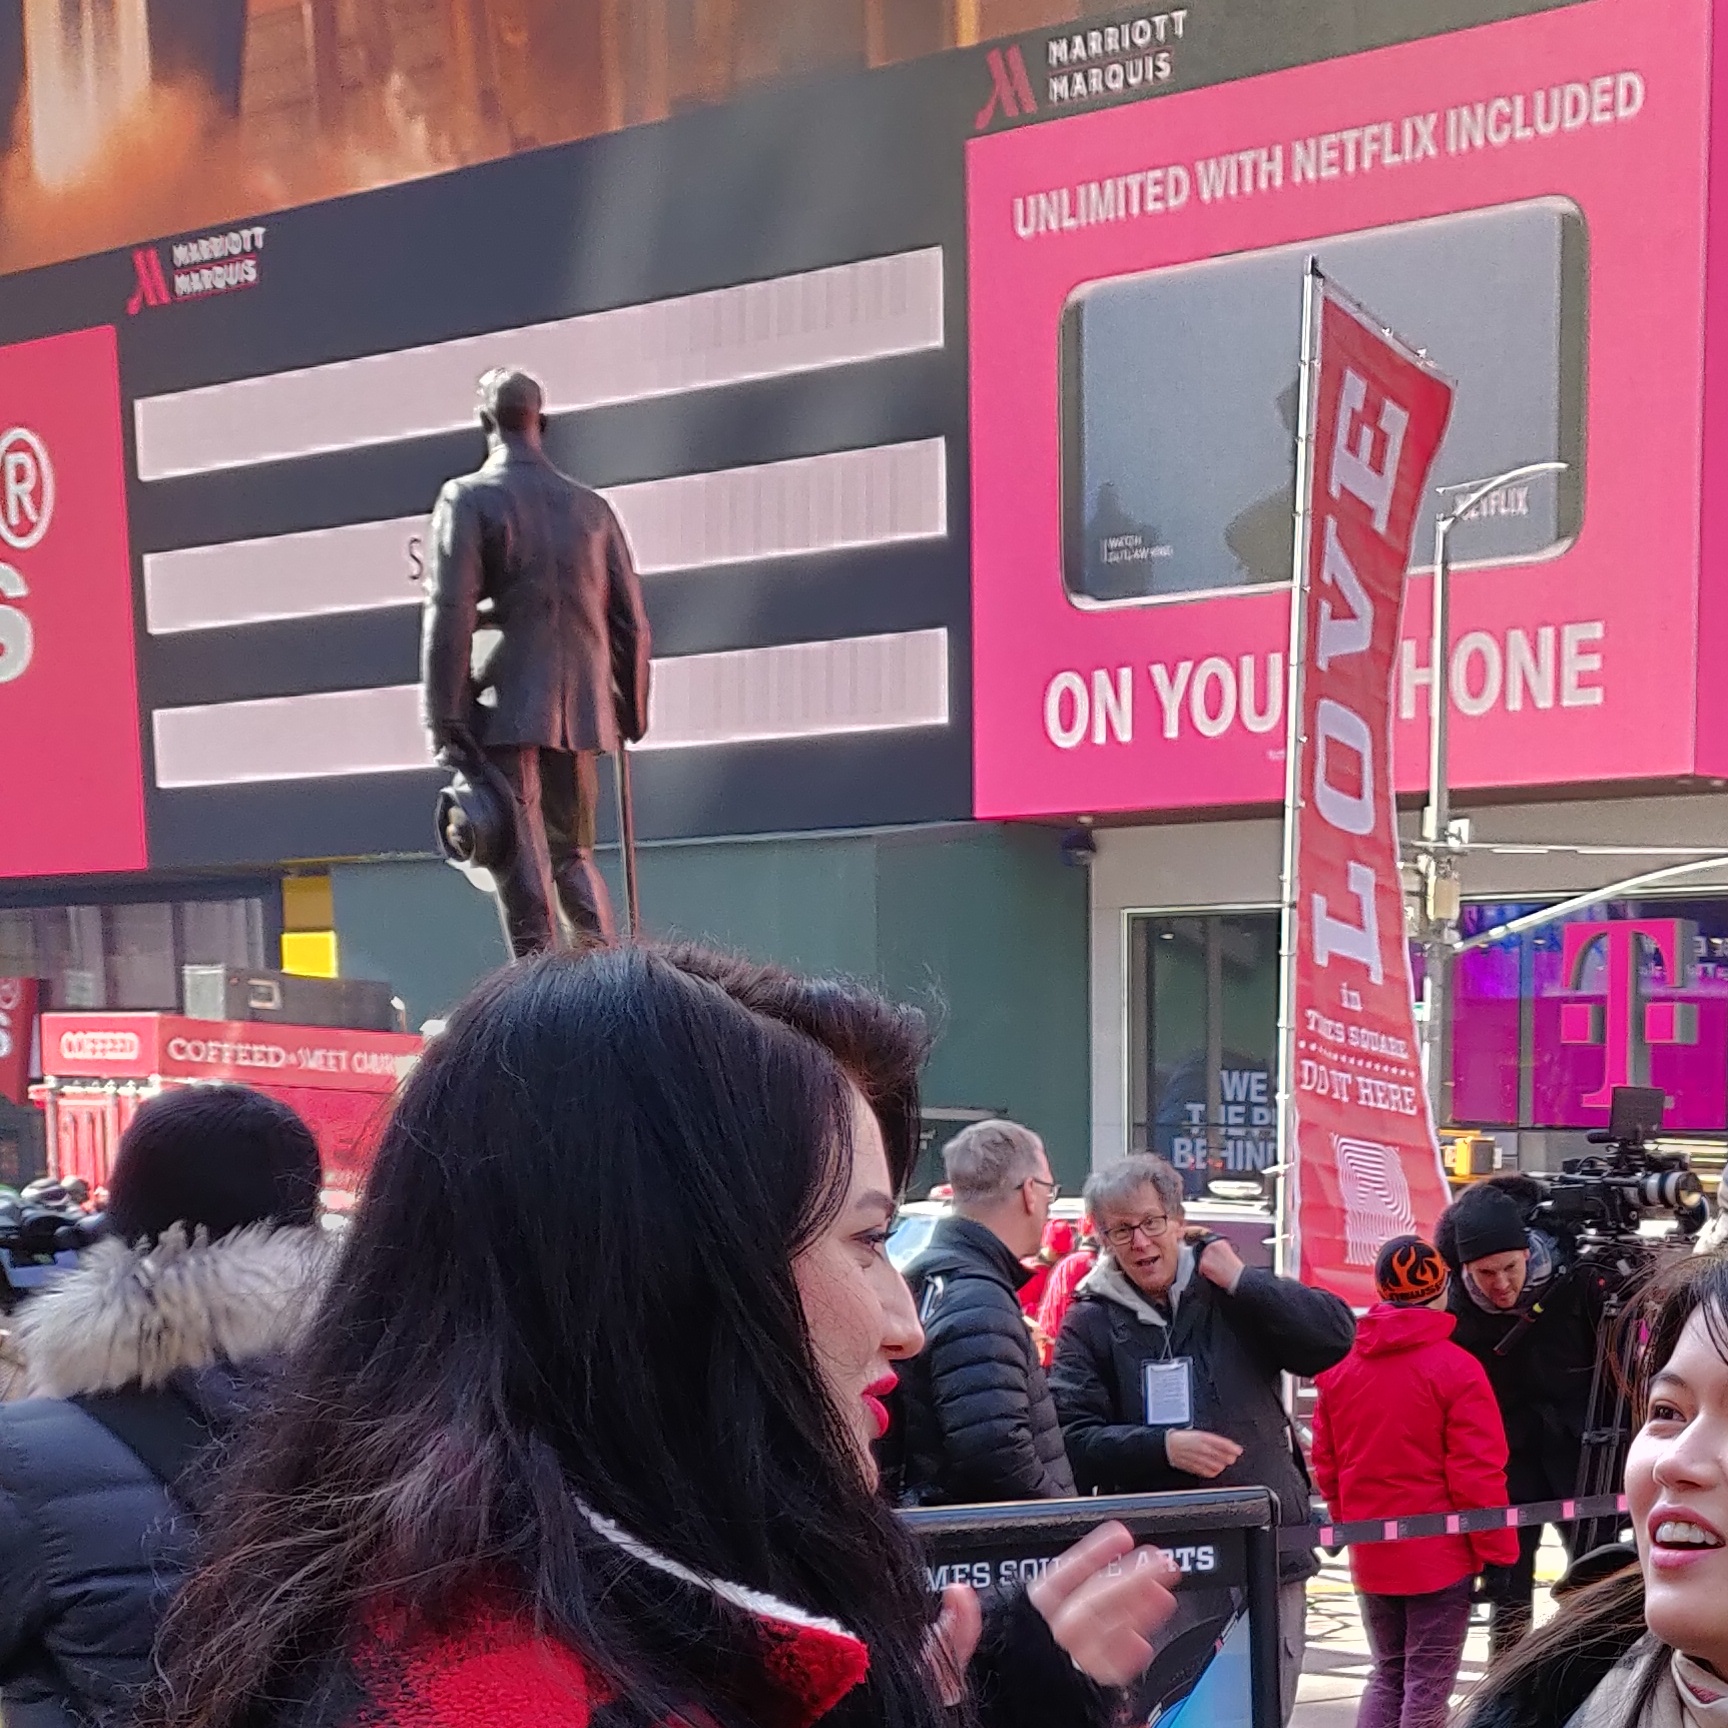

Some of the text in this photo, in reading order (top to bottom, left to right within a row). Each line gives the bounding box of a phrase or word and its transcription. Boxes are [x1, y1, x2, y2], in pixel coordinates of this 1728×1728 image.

[1048, 9, 1187, 65] MARRIOTT
[1049, 50, 1173, 103] MARQUIS
[1013, 71, 1646, 239] UNLIMITED WITH NETFLIX INCLUDED
[173, 227, 266, 268] MARRIOTT
[174, 259, 258, 297] MARQUIS
[1043, 620, 1606, 749] ON YOU HONE
[1340, 982, 1363, 1012] in
[167, 1037, 286, 1069] COFFEED
[1347, 1025, 1409, 1060] SQUARE
[1220, 1070, 1268, 1103] WE
[1356, 1076, 1418, 1116] HERE
[924, 1561, 992, 1593] MES
[1000, 1555, 1122, 1586] SQUE
